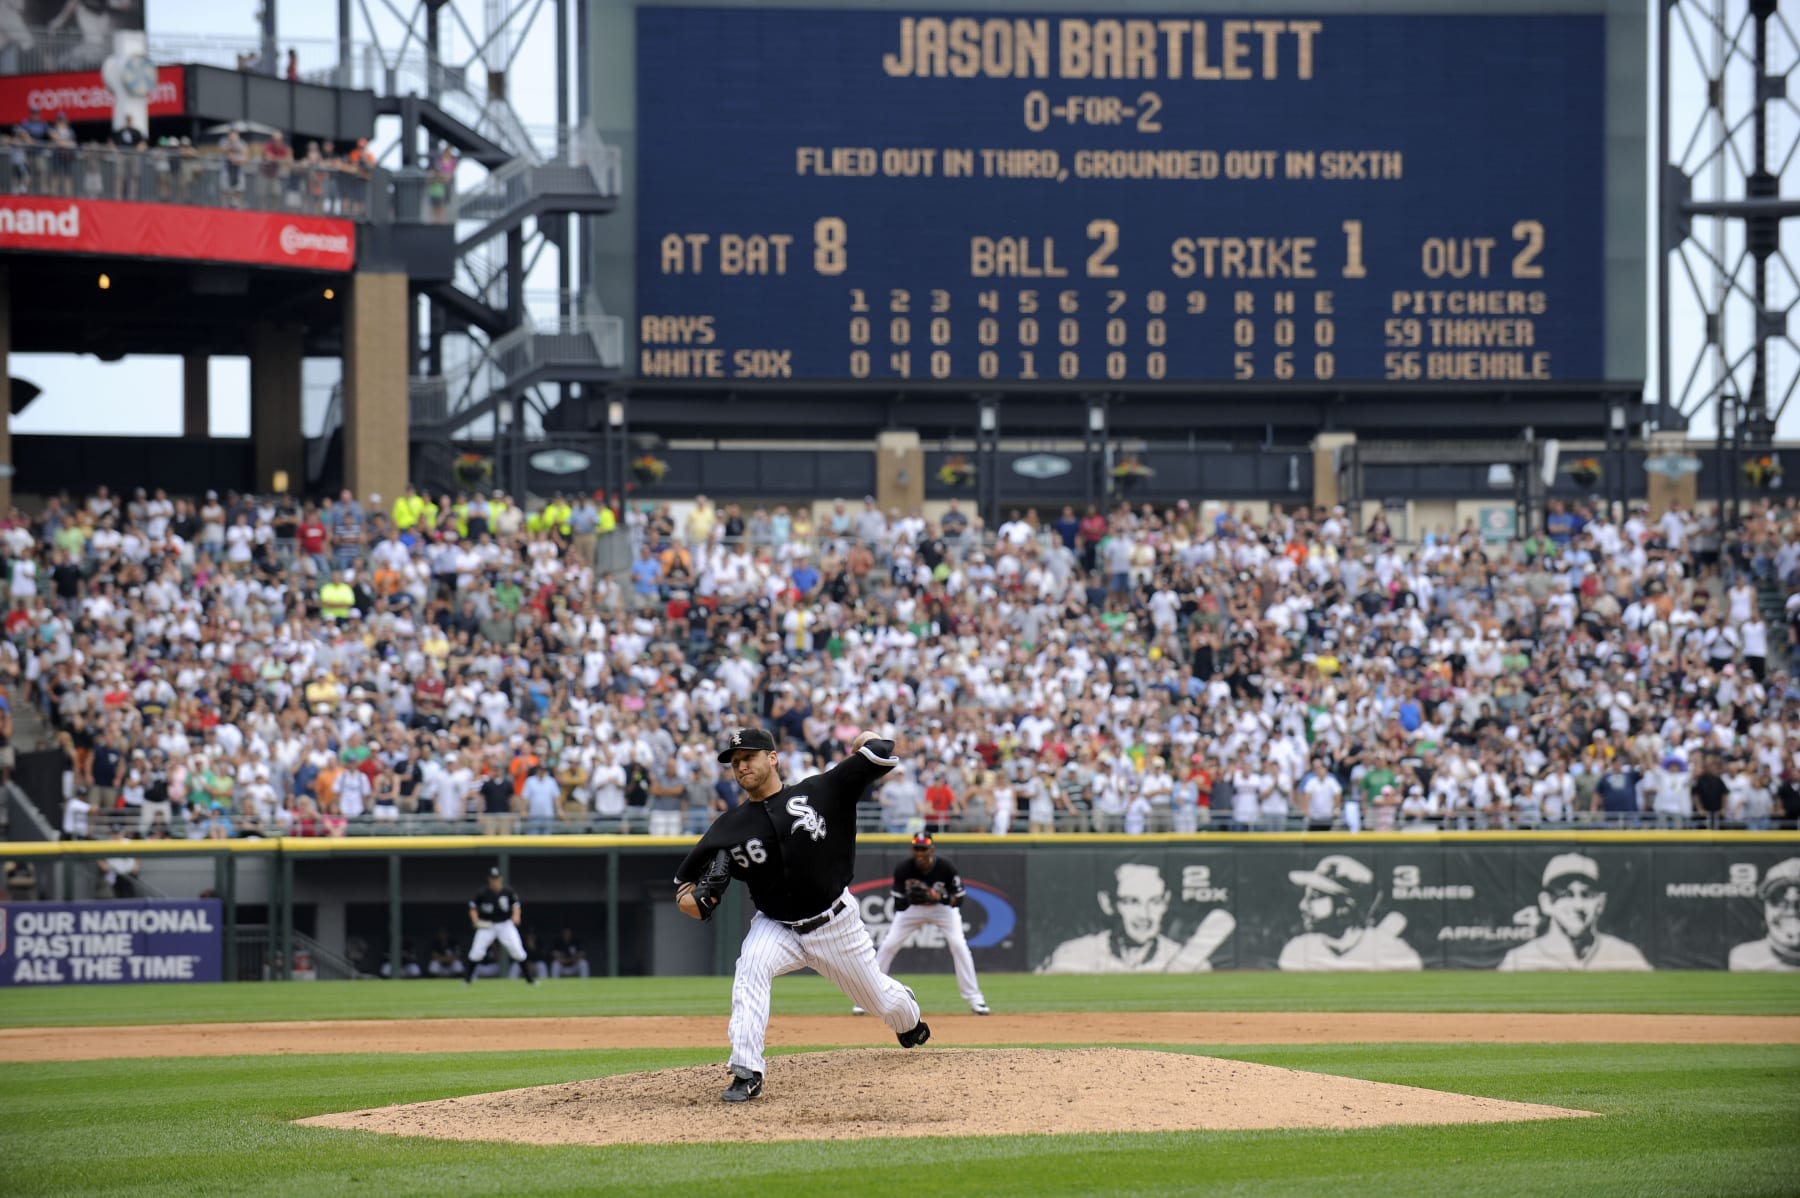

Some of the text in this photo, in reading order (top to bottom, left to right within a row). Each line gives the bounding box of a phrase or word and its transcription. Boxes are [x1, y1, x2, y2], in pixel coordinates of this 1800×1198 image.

[883, 17, 1322, 80] JASON BARTLETT
[1024, 91, 1162, 132] 0-FOR-2
[797, 148, 1402, 181] FLIED OUT IN THIRD, GROUNDED OUT IN SIXTH
[661, 217, 847, 275] AT BAT 8
[971, 220, 1119, 277] BALL 2
[1172, 221, 1367, 278] STRIKE 1
[1422, 221, 1544, 278] OUT 2
[850, 289, 869, 312] 1
[890, 290, 910, 312] 2
[931, 290, 950, 313] 3
[979, 291, 999, 313] 4
[1019, 291, 1039, 313] 5
[1059, 291, 1078, 313] 6
[1107, 291, 1127, 313] 7
[1188, 291, 1207, 314] 9
[1234, 292, 1254, 314] R
[1275, 292, 1294, 314] H
[1315, 292, 1335, 314] E
[1391, 291, 1546, 314] PITCHERS
[641, 316, 1334, 346] RAYS 0 0 0 0 0 0 0 0 0 0 0
[1385, 319, 1534, 346] 59 THAYER
[642, 350, 1334, 379] WHITE SOX 0 4 0 0 1 0 0 0 5 6 0
[1385, 352, 1550, 380] 56 BUEHRLE
[730, 838, 768, 869] 56
[1182, 865, 1211, 887] 2
[1393, 865, 1420, 886] 3
[1729, 862, 1758, 883] 9
[1182, 887, 1229, 901] FOX
[1392, 886, 1475, 900] BAINES
[1666, 883, 1757, 898] MINOSO
[14, 909, 213, 935] OUR NATIONAL
[1512, 905, 1541, 927] 4
[14, 933, 133, 959] PASTIME
[1437, 926, 1537, 941] APPLING
[14, 958, 64, 982] ALL
[69, 957, 123, 980] THE
